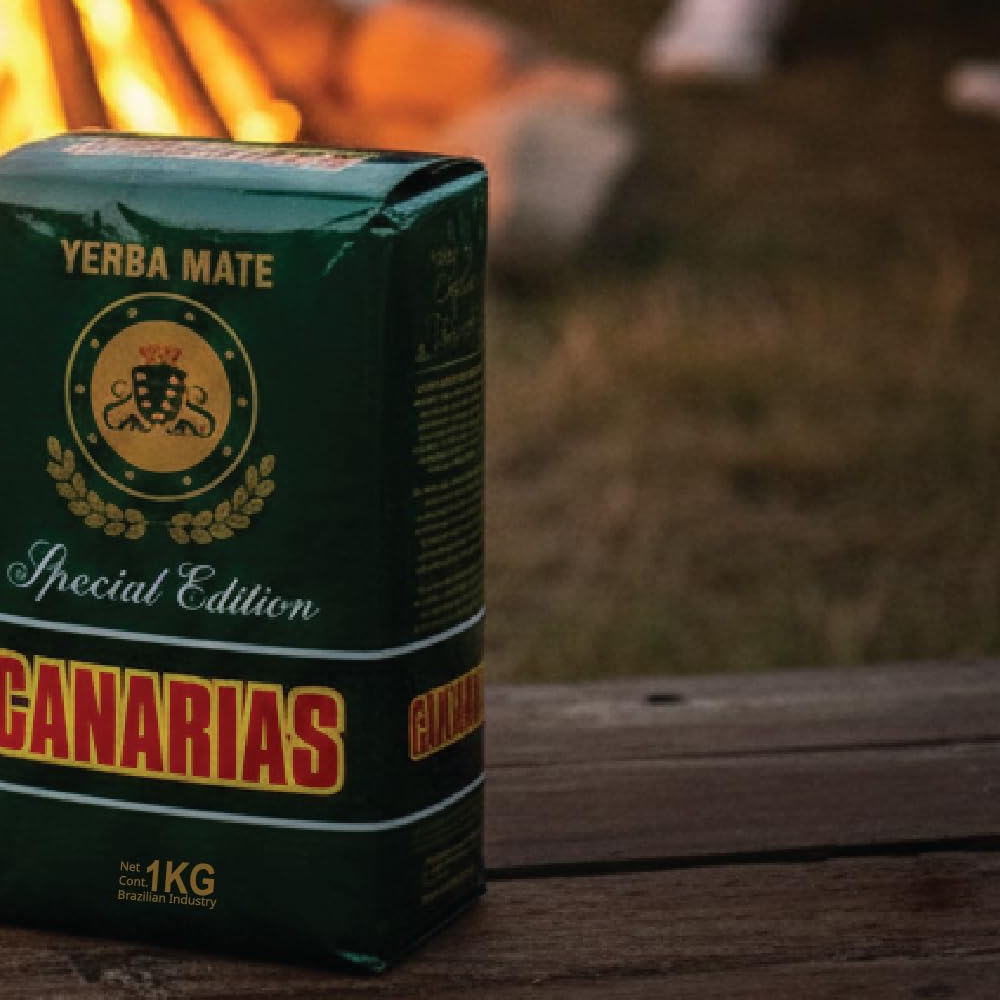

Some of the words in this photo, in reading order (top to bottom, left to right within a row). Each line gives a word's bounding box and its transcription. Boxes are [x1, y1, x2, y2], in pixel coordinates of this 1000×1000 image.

[60, 239, 168, 281] YERBA
[182, 248, 275, 289] MATE
[7, 539, 171, 606] Special
[177, 562, 320, 621] Edition
[120, 861, 141, 872] Net
[146, 859, 215, 896] 1KG
[118, 875, 149, 888] Cont.
[117, 889, 166, 904] Brazilian
[169, 893, 217, 910] Industry
